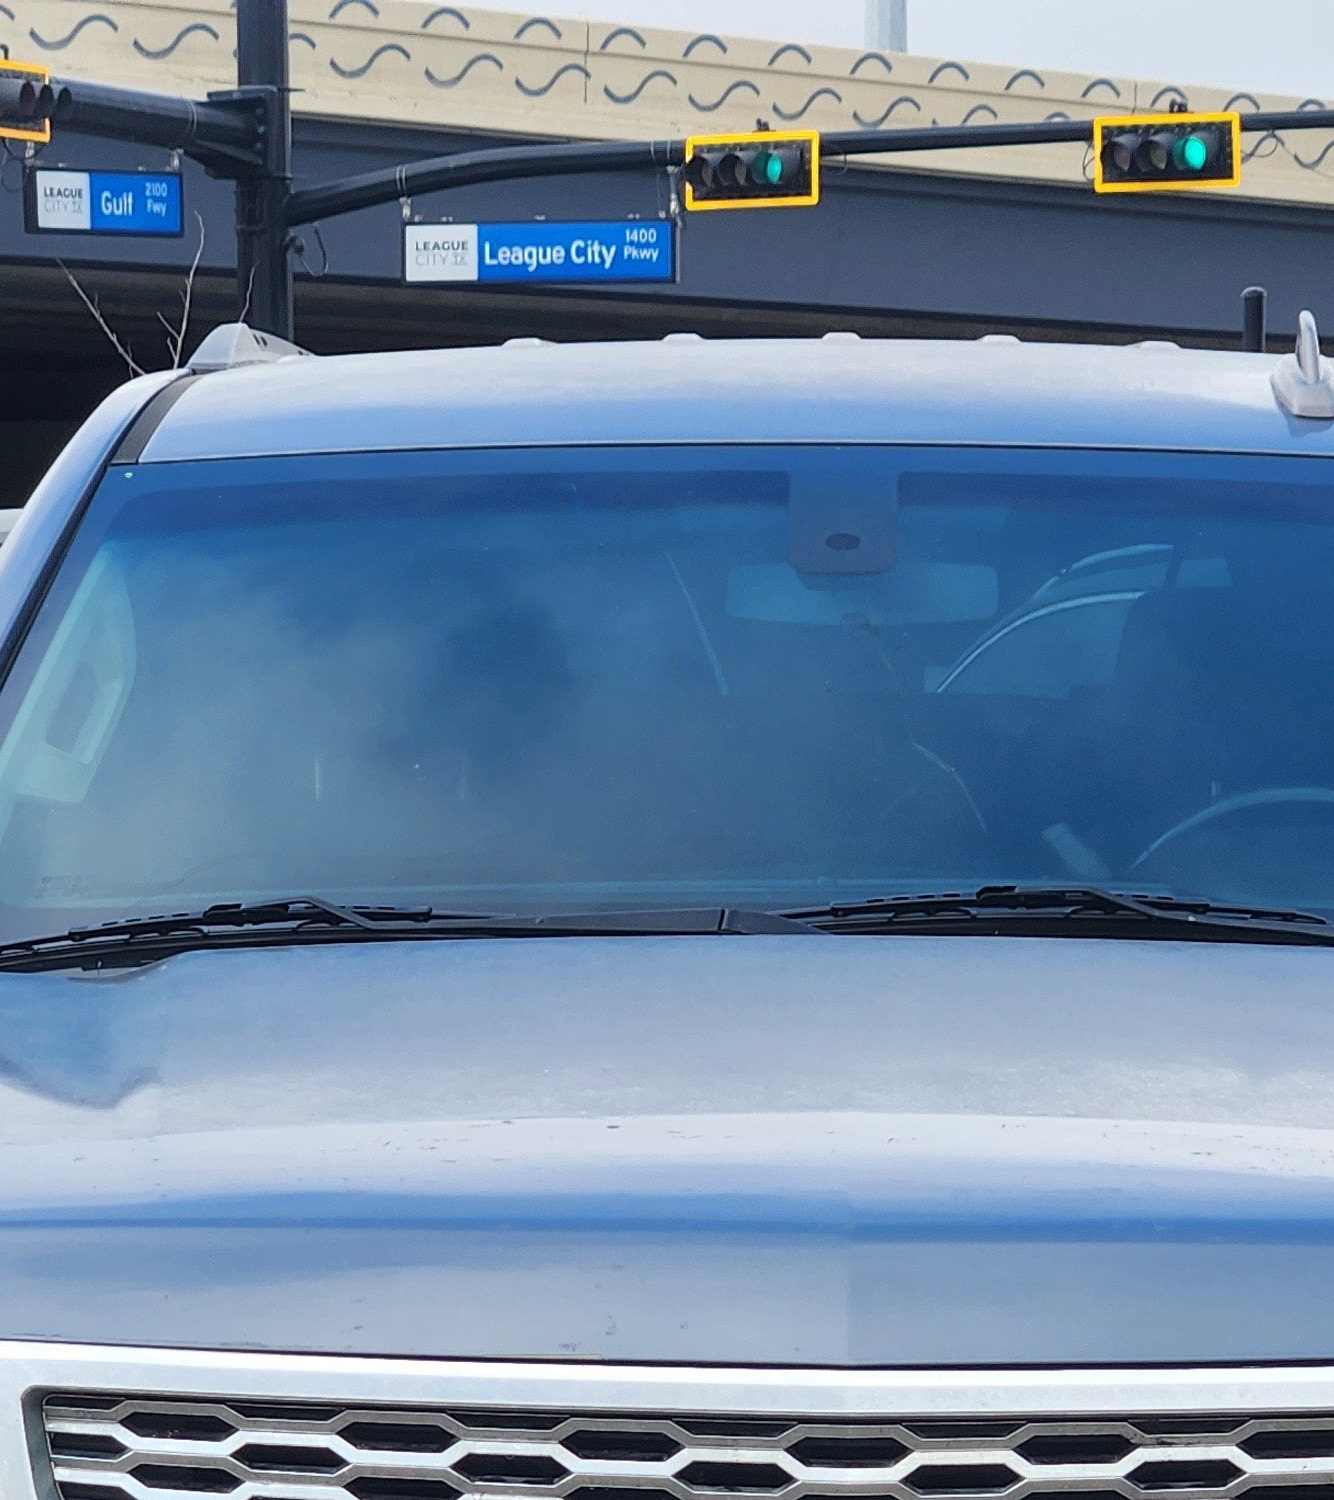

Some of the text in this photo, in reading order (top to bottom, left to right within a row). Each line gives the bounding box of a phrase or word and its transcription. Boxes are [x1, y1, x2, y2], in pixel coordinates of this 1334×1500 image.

[43, 187, 83, 198] LEAGUE
[145, 182, 167, 198] 2100
[44, 201, 68, 213] CITY
[101, 190, 133, 216] Gulf
[147, 199, 167, 217] Fwy
[624, 228, 657, 242] 1400
[415, 240, 468, 252] LEAGUE
[415, 254, 447, 267] CITY
[484, 239, 616, 272] League City
[623, 247, 659, 263] Pkwy
